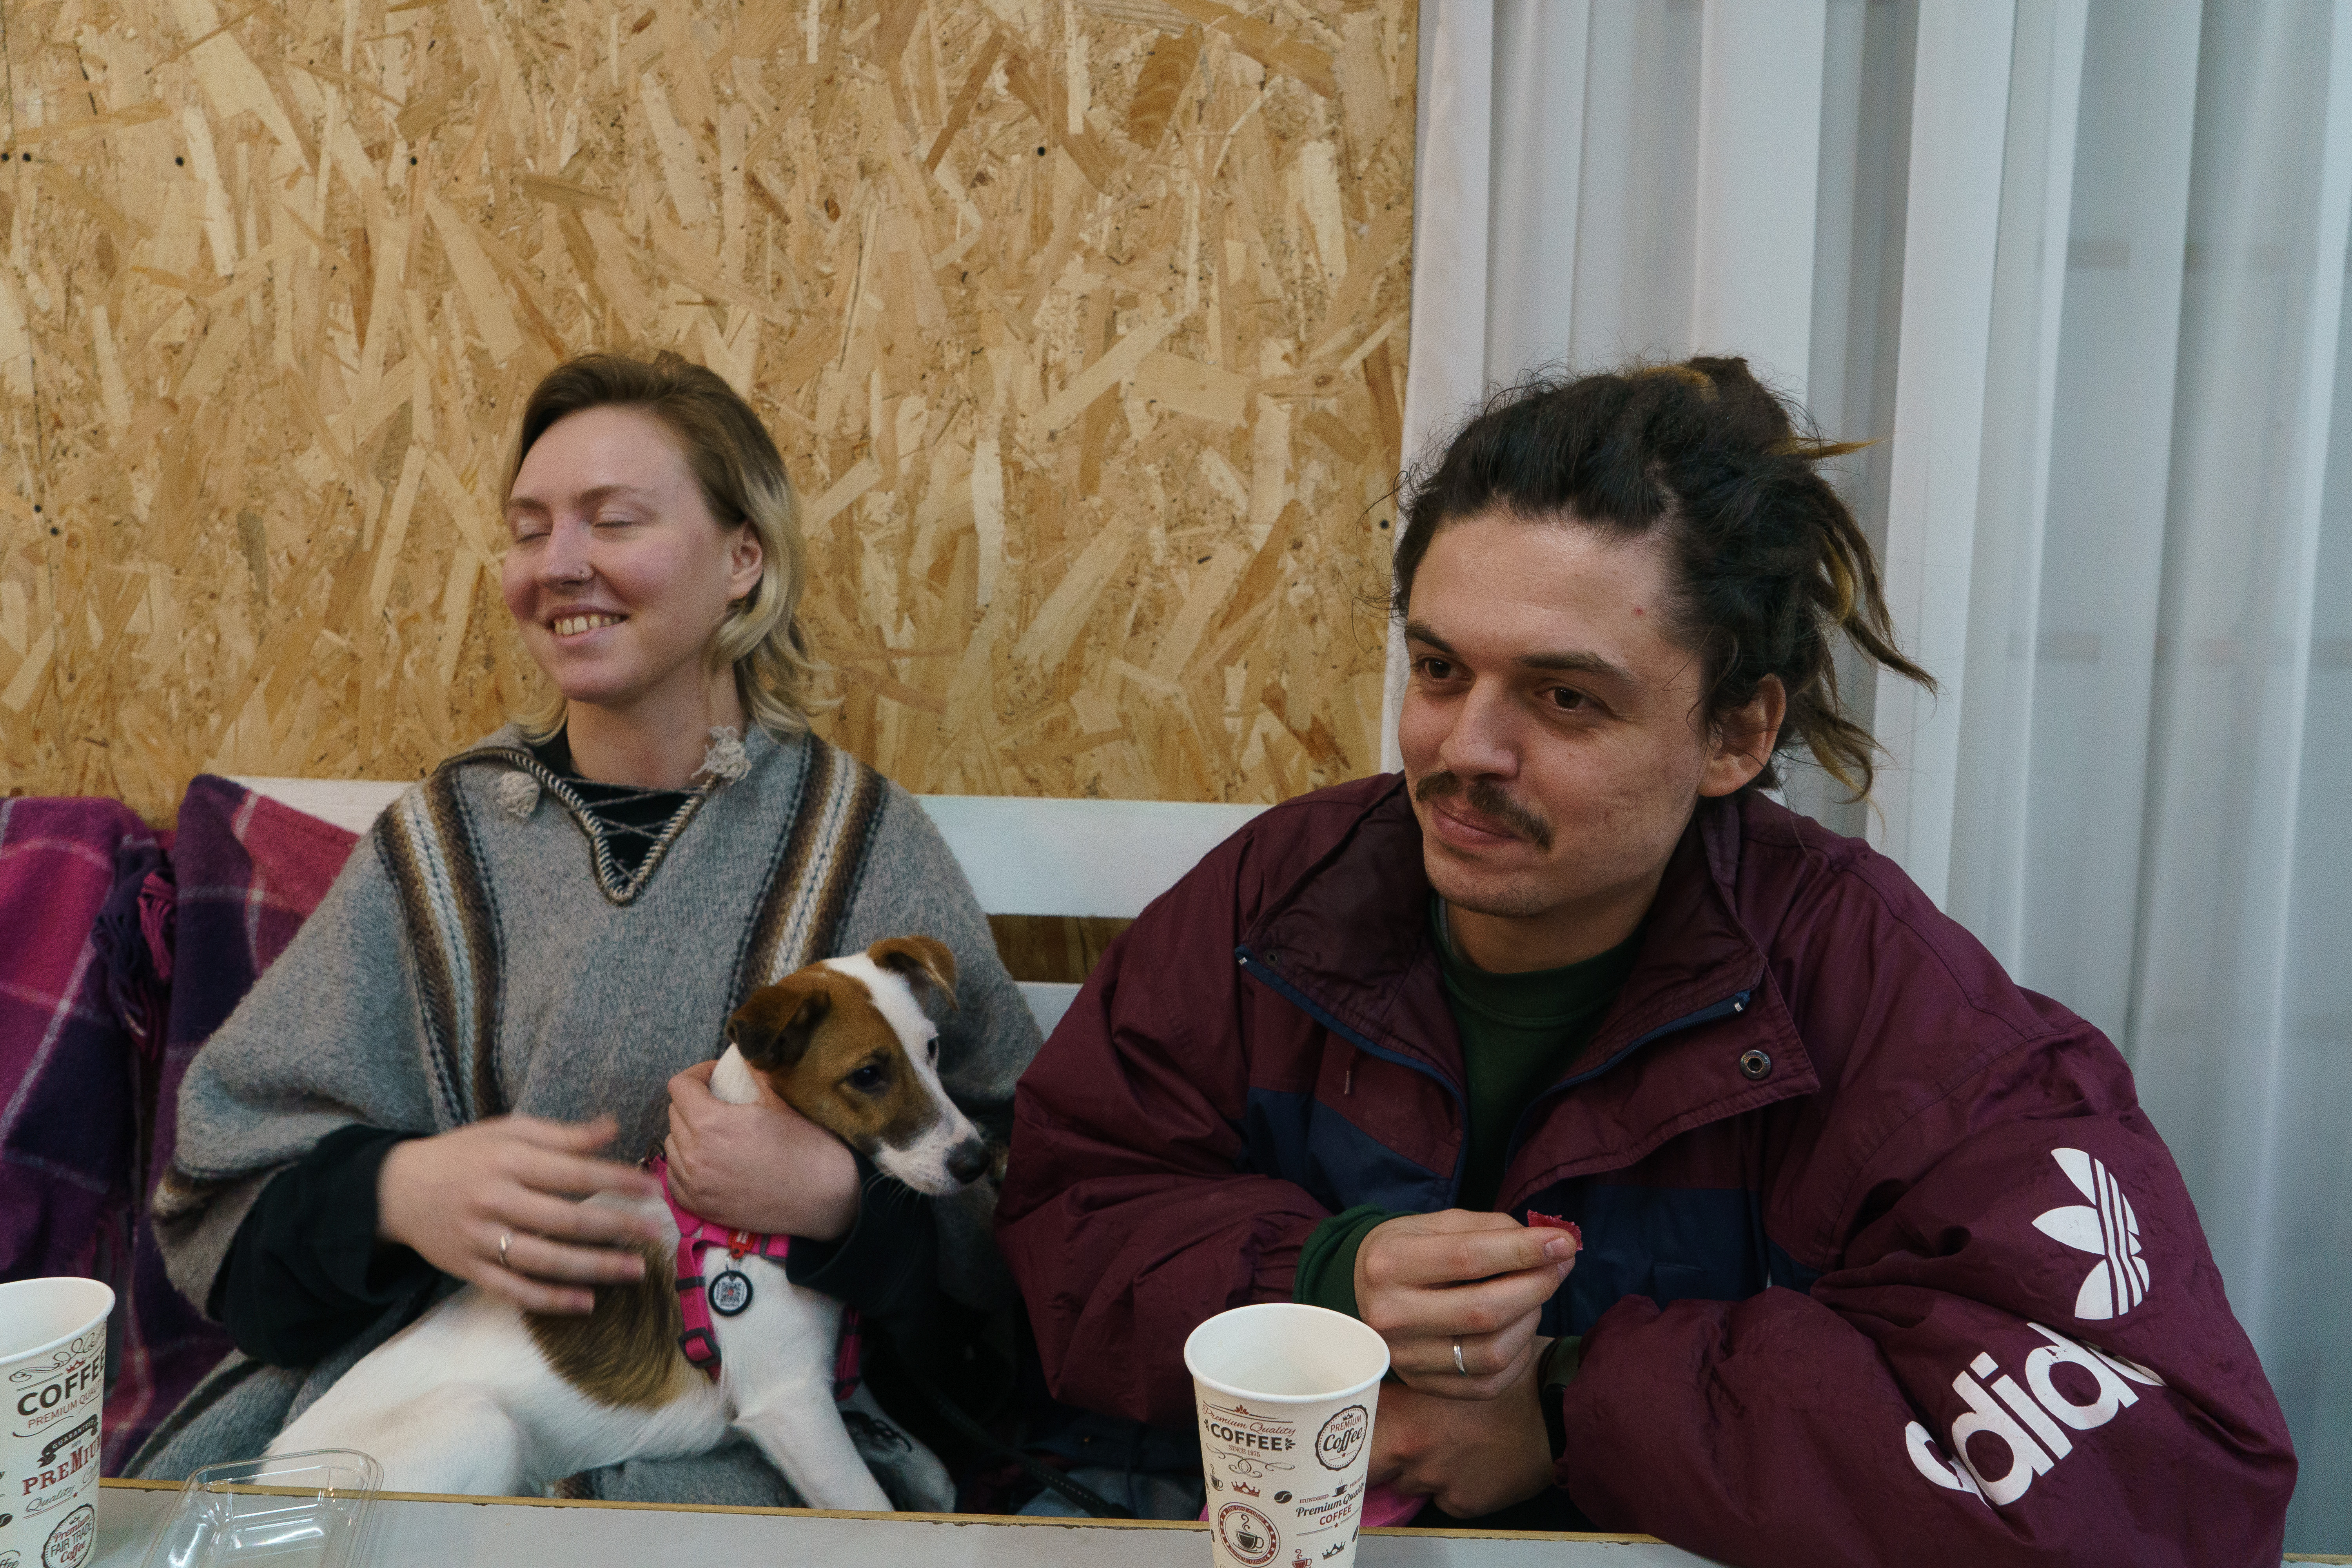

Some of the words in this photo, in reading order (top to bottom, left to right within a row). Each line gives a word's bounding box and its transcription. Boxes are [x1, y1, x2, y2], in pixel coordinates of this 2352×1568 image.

[17, 1348, 105, 1416] COFFEE
[27, 1399, 77, 1428] PREMIUM
[1202, 1404, 1247, 1429] Premium
[1250, 1422, 1296, 1437] Quality
[1330, 1414, 1361, 1433] PREMIUM
[1210, 1423, 1282, 1451] COFFEE
[1228, 1444, 1246, 1454] SINCE
[1323, 1427, 1363, 1453] Coffee
[26, 1485, 74, 1512] Quality
[1296, 1500, 1342, 1517] Premium
[1299, 1494, 1329, 1504] HUNDRED
[1319, 1503, 1352, 1525] COFFEE
[51, 1538, 70, 1557] FAIR
